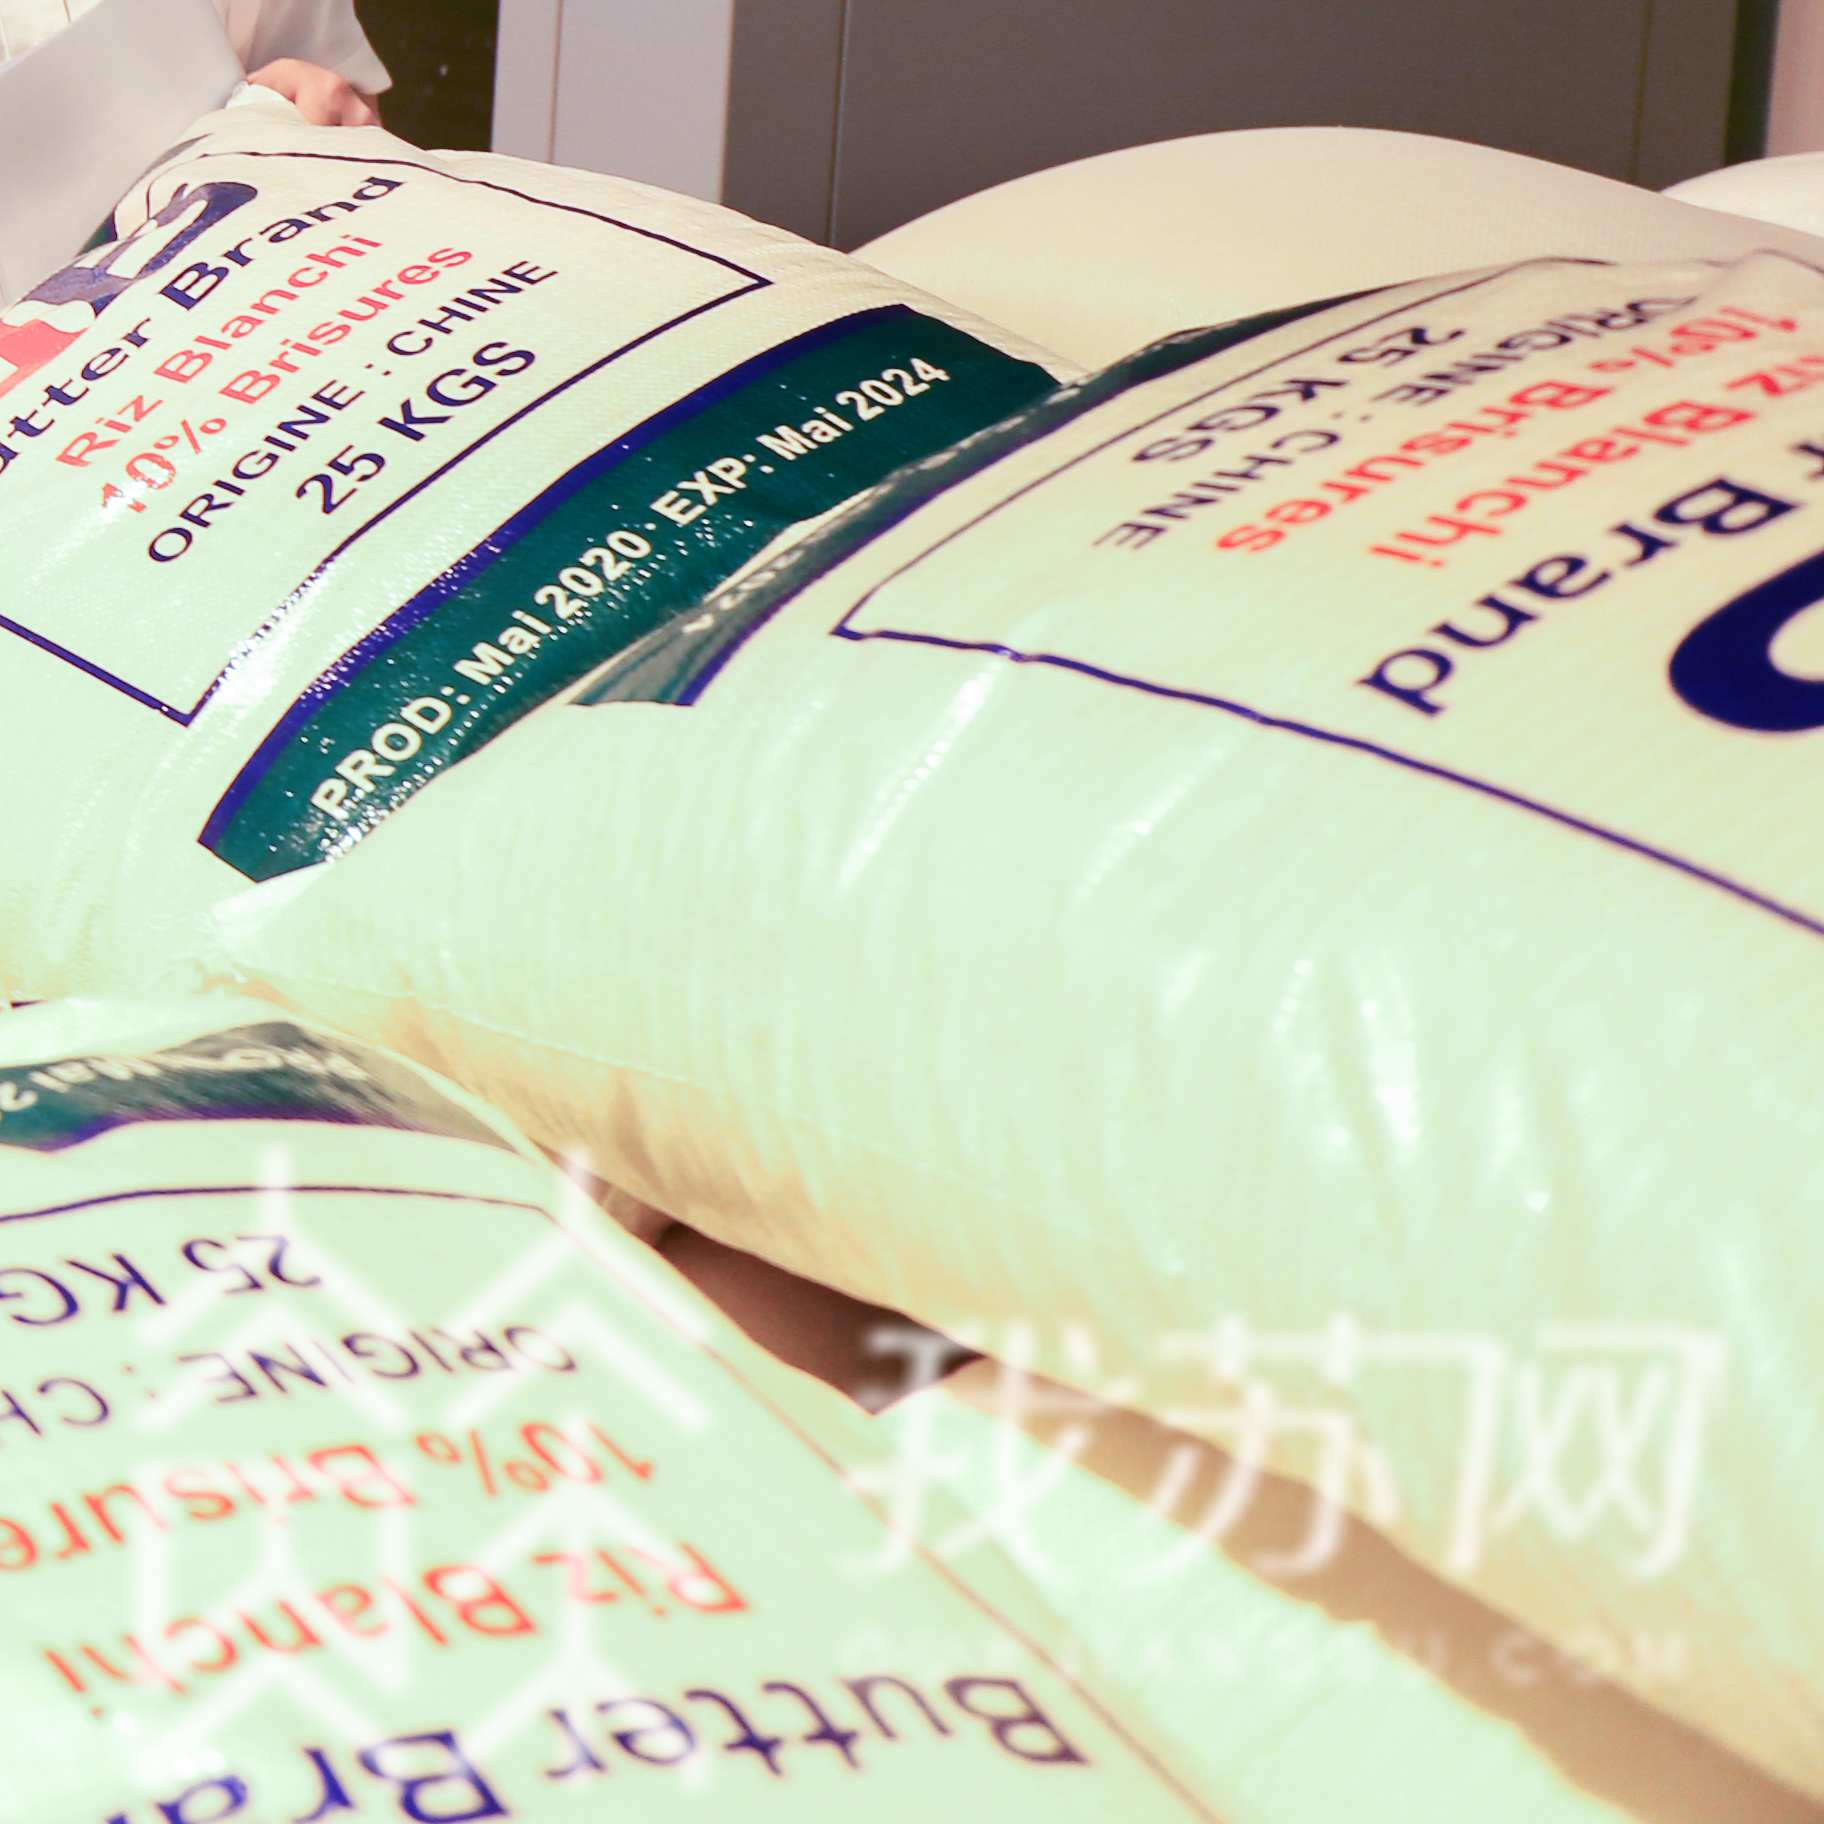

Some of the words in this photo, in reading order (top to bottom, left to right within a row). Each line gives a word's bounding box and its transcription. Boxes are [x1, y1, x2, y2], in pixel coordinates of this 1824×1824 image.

[160, 176, 408, 311] Brand
[55, 394, 164, 468] Riz
[154, 233, 384, 384] Blanchi
[100, 417, 228, 514] 10%
[219, 247, 474, 405] Brisures
[147, 379, 366, 563] ORIGINE
[385, 260, 559, 357] CHINE
[1336, 326, 1467, 368] 25
[295, 445, 386, 515] 25
[378, 341, 537, 442] KGS
[1091, 429, 1341, 551] CHINE
[1131, 379, 1350, 463] KGS
[1215, 380, 1615, 553] Brisures
[1367, 400, 1758, 570] Blanchi
[309, 683, 471, 822] PROD:
[453, 608, 553, 688] Mai
[534, 528, 654, 620] 2020
[650, 453, 776, 527] EXP:
[756, 406, 854, 463] Mai
[835, 356, 952, 422] 2024
[1355, 476, 1803, 720] Brand
[181, 1234, 324, 1295] 25
[175, 1325, 578, 1405] ORIGINE
[415, 1420, 656, 1500] 10%
[42, 1564, 541, 1723] Blanchi
[530, 1540, 752, 1620] Riz
[544, 1672, 1092, 1779] Butter
